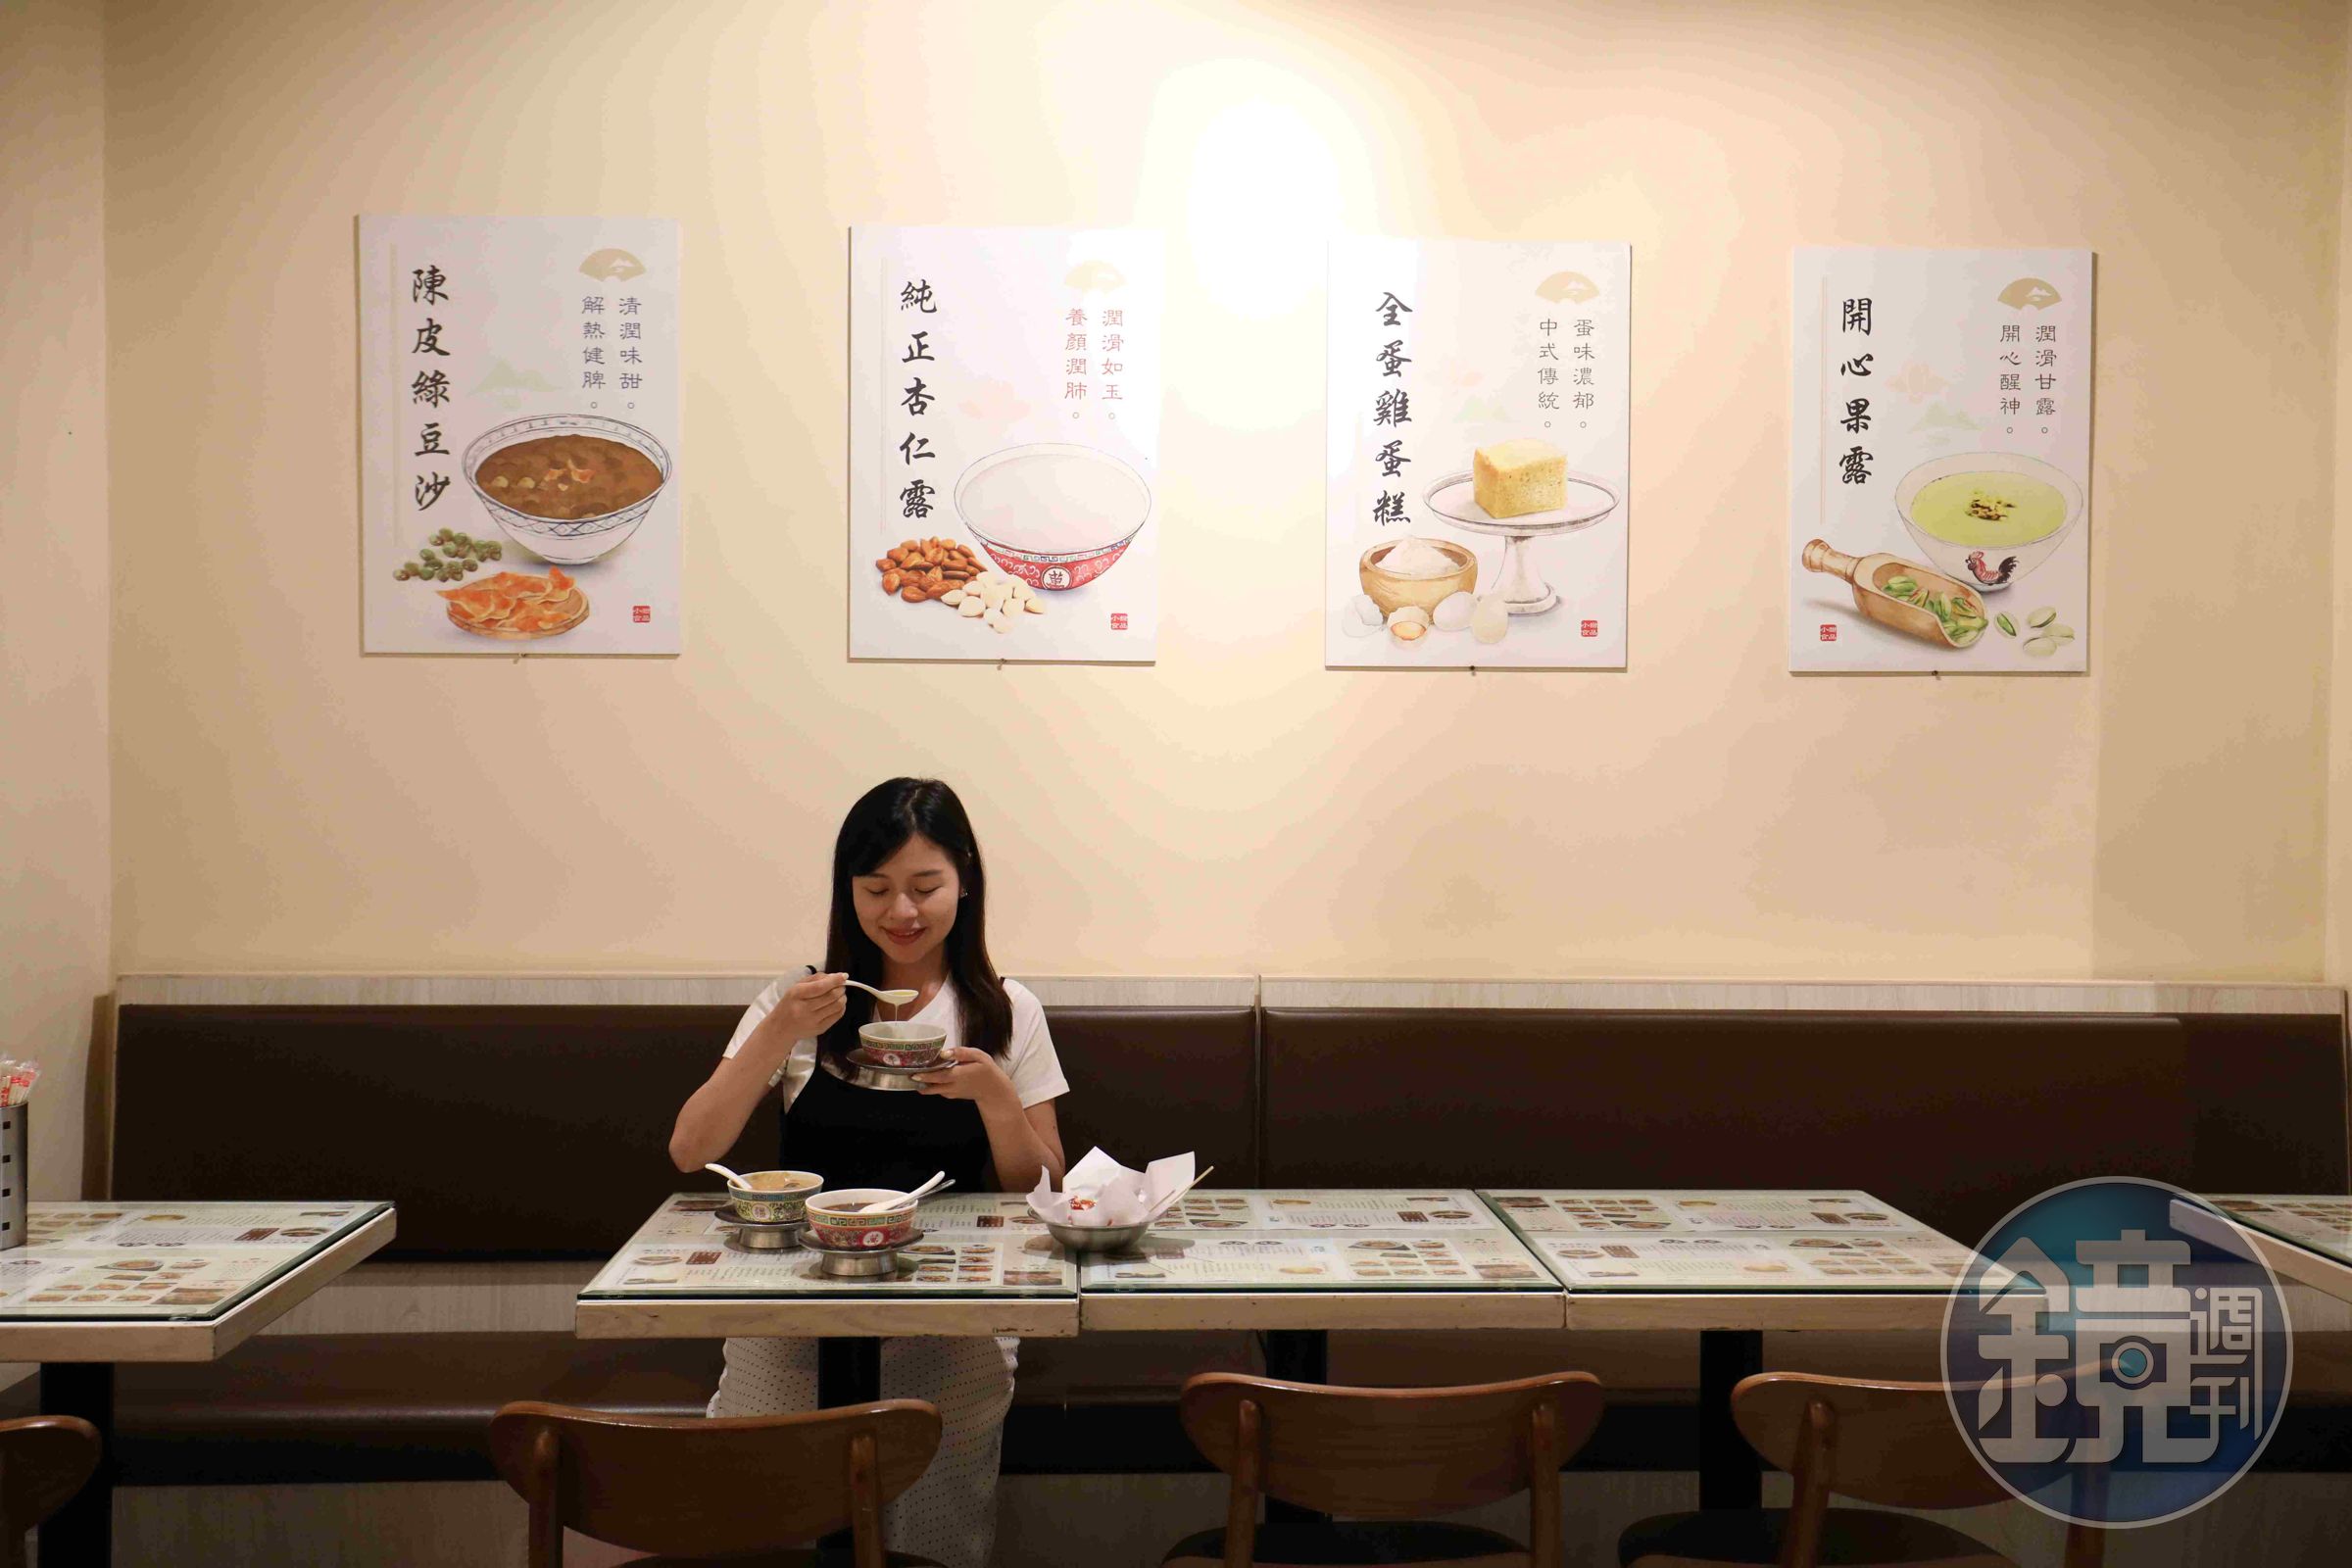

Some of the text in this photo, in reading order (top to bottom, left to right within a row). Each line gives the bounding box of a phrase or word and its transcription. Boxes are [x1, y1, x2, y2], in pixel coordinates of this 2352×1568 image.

[411, 265, 451, 511] 陳皮綠豆沙
[900, 278, 937, 518] 純正杏仁露
[1372, 292, 1413, 526] 全蛋雞蛋糕
[1838, 298, 1874, 484] 開心果露
